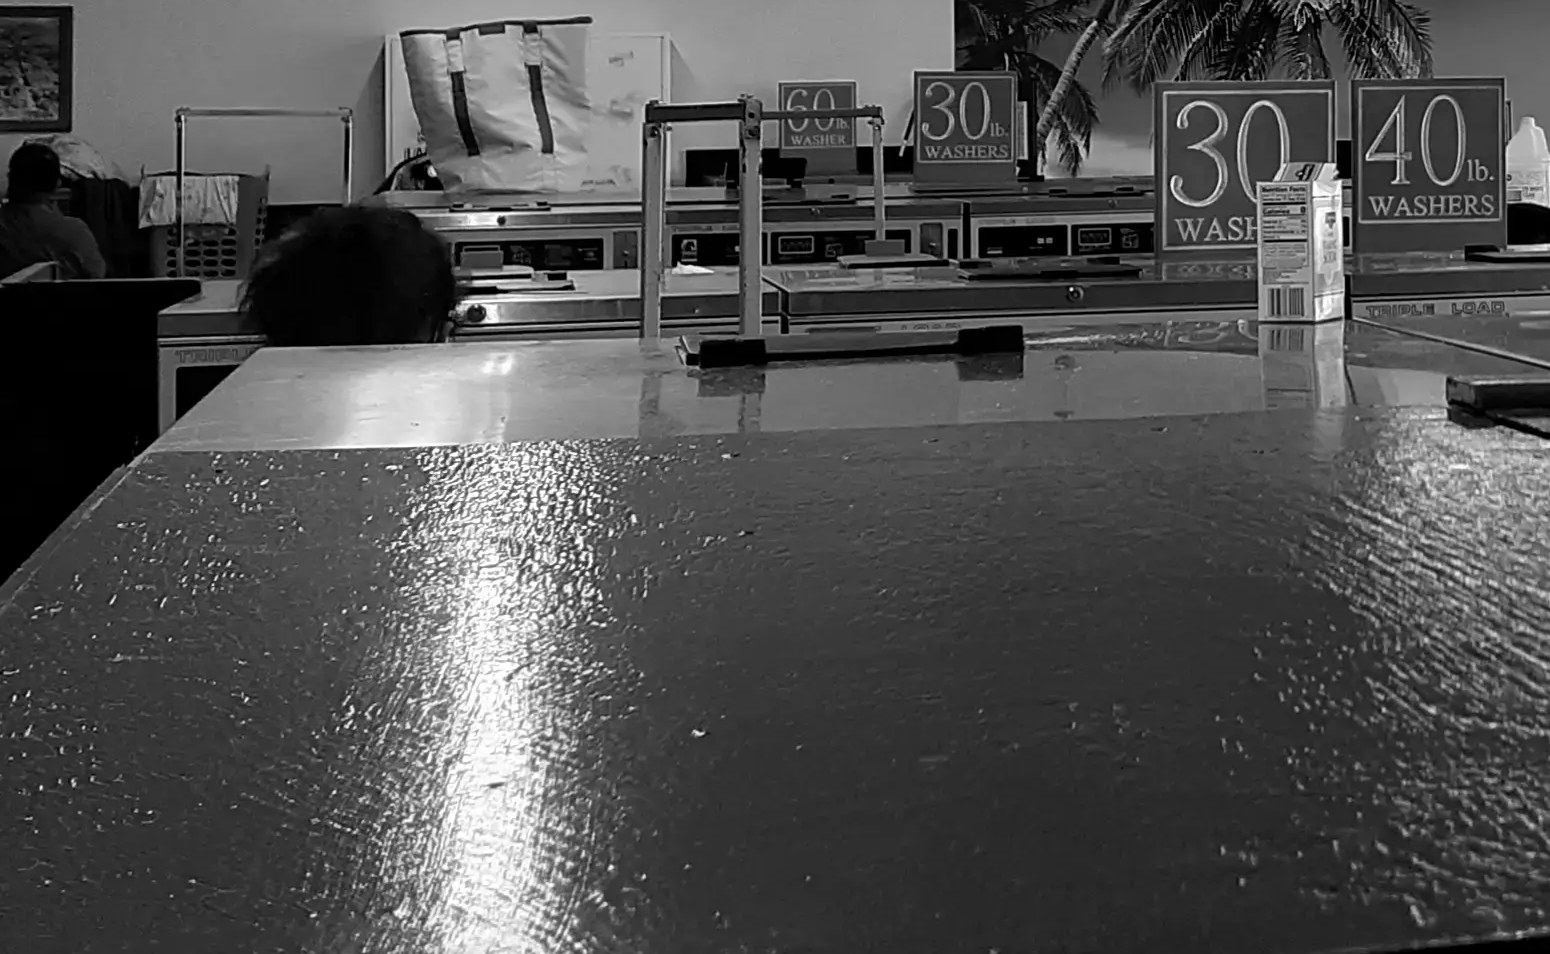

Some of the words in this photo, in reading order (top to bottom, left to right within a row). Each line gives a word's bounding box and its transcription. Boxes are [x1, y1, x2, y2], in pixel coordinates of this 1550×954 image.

[786, 88, 836, 133] 60
[921, 81, 991, 141] 30
[989, 122, 1009, 138] lb.
[790, 134, 847, 145] WASHER
[923, 144, 1009, 159] WASHERS
[1170, 99, 1290, 208] 30
[1365, 94, 1467, 187] 40
[1466, 159, 1495, 182] lb.
[1368, 194, 1495, 217] WASHERS
[1366, 303, 1435, 317] TRIPLE
[1452, 301, 1505, 315] LOAD
